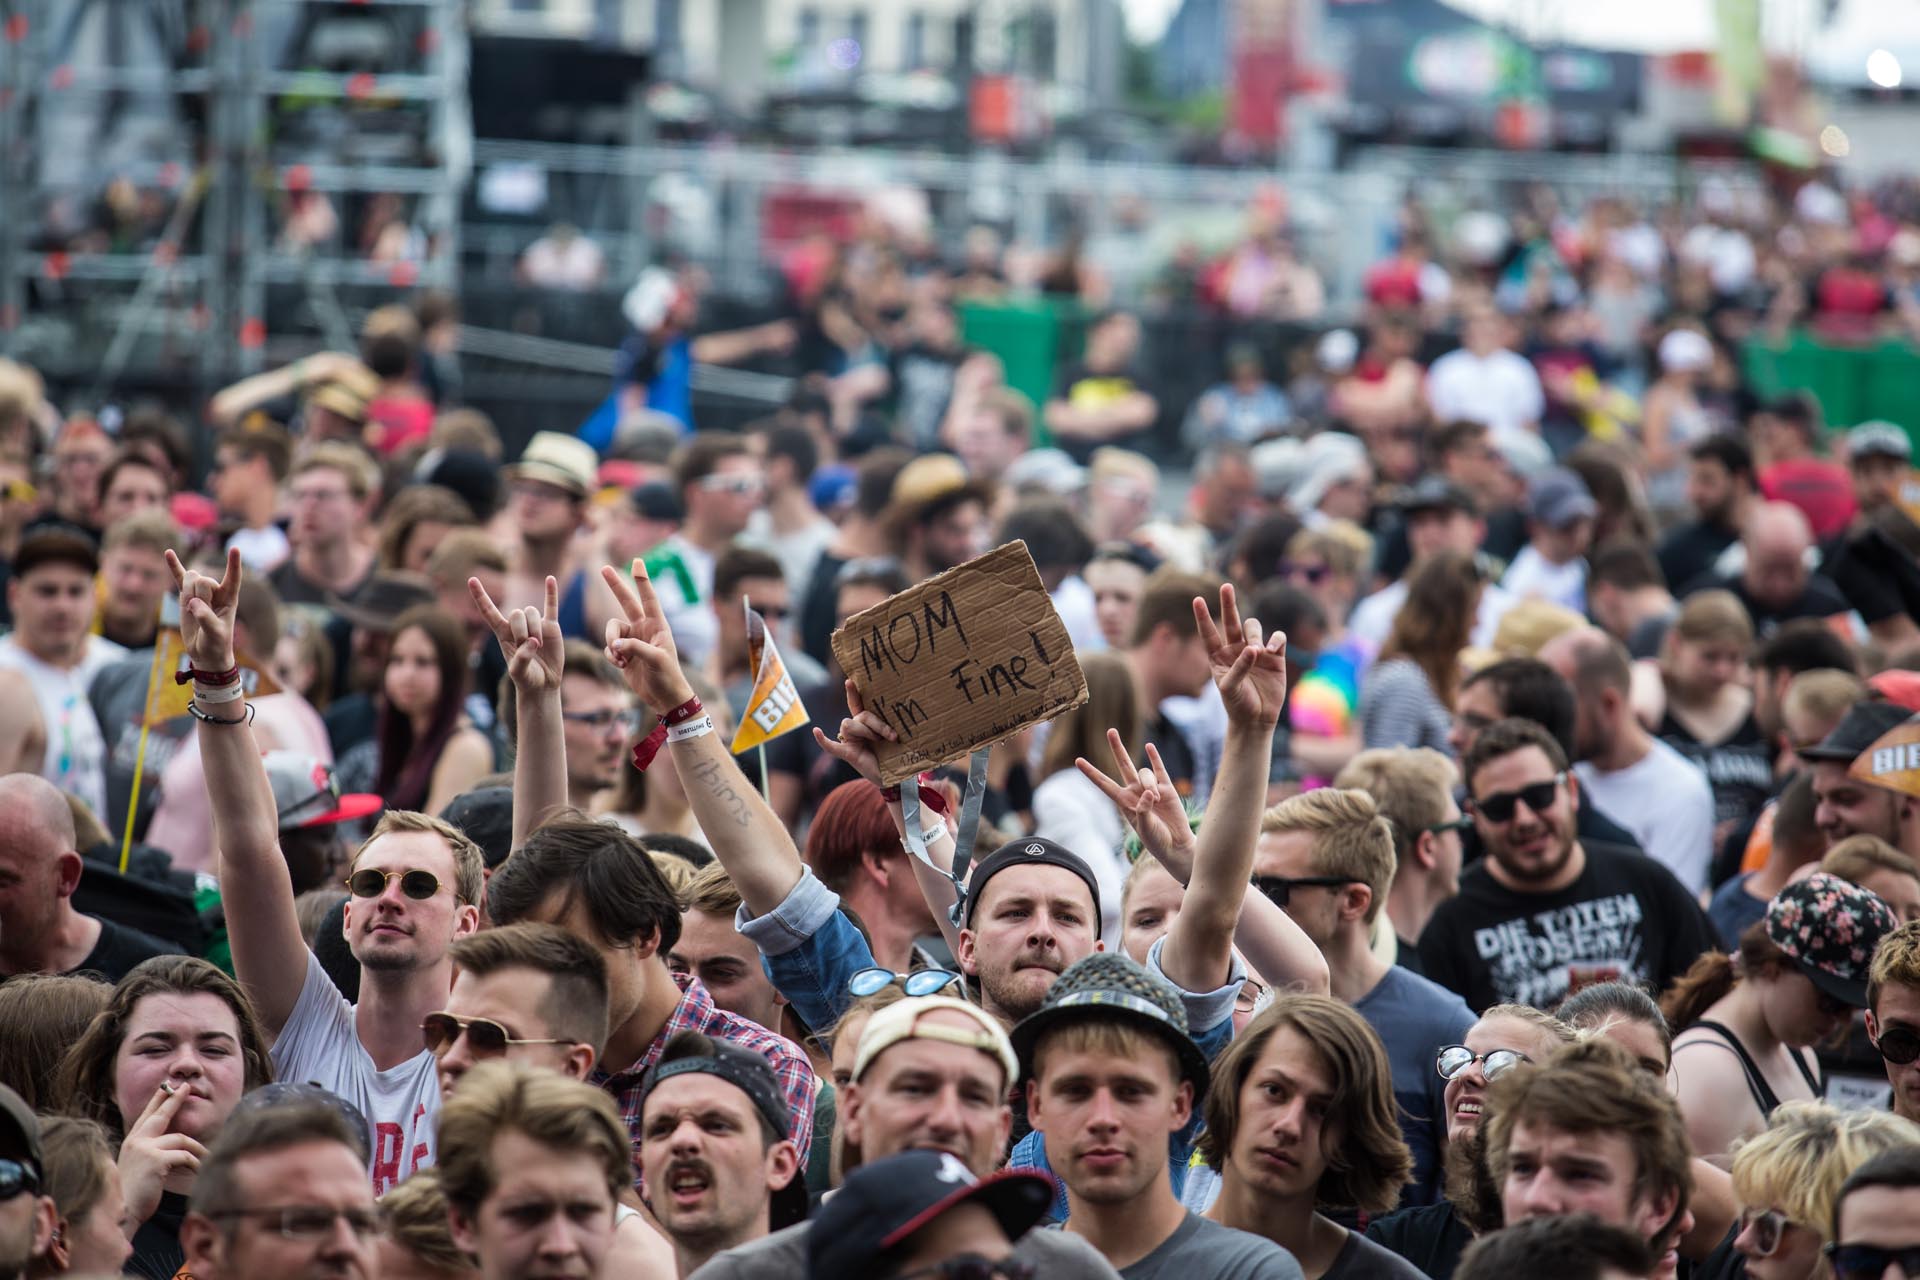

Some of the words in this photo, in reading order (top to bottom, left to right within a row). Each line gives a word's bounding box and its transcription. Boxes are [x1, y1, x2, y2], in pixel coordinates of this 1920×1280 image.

[860, 590, 970, 682] MOM
[1474, 917, 1531, 960] DIE
[1533, 892, 1643, 938] TOTEN
[1500, 927, 1623, 977] HOSEN
